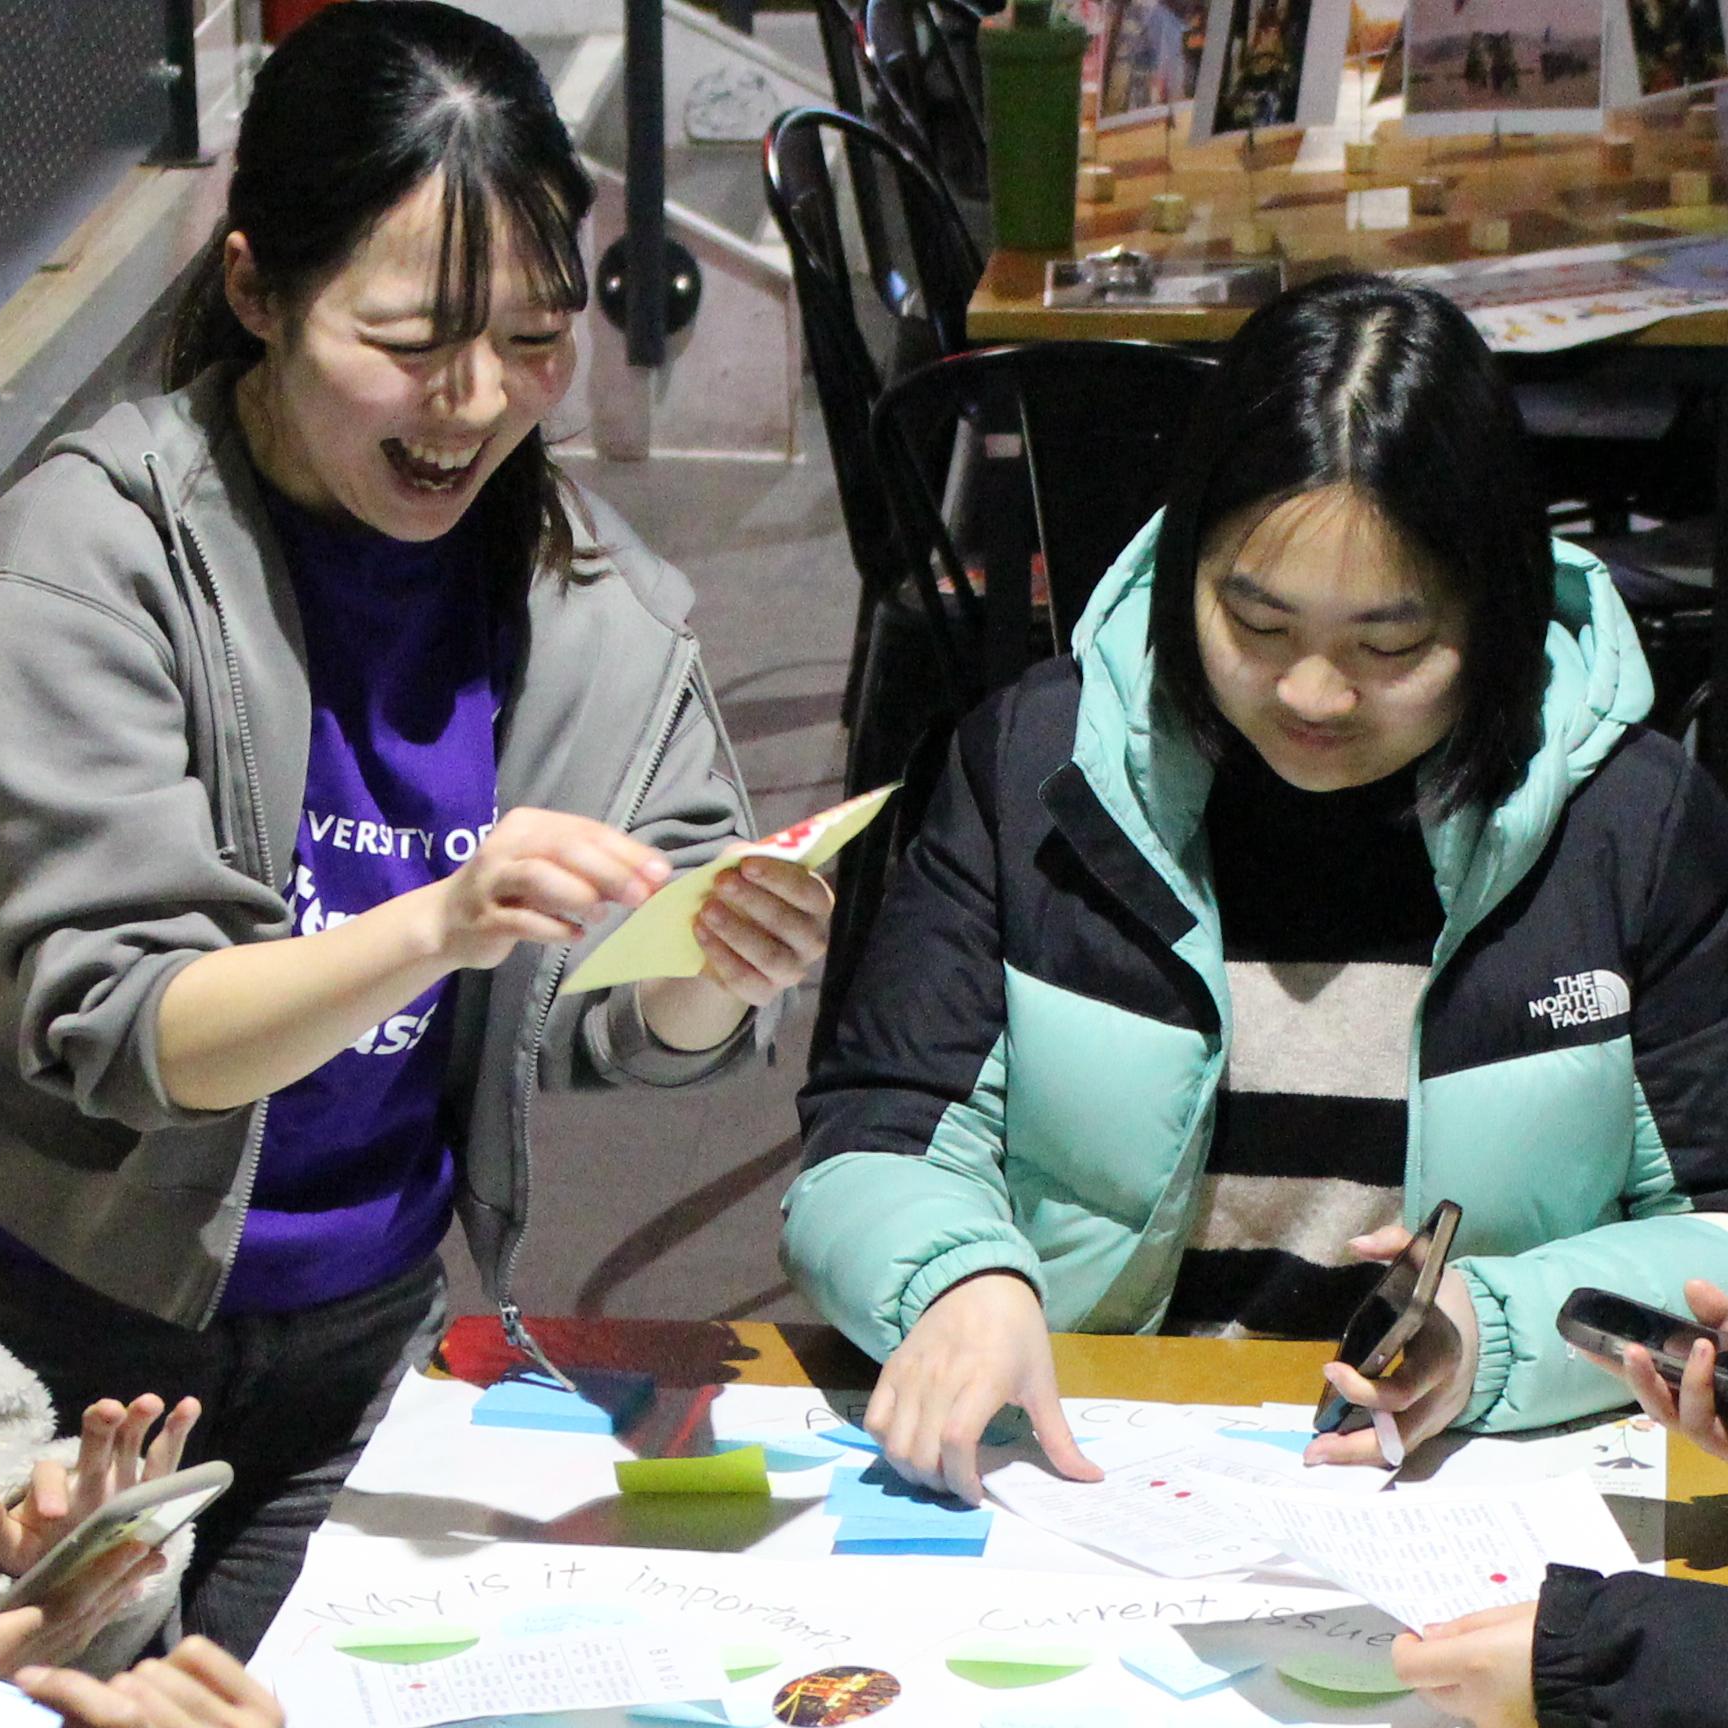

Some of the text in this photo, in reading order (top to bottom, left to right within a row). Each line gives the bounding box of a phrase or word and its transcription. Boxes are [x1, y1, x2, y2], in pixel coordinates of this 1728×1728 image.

[306, 809, 435, 861] VERSITY
[1553, 970, 1594, 994] THE
[1527, 988, 1597, 1018] NORTH
[1550, 1007, 1603, 1030] FACE
[304, 1586, 445, 1630] Why
[467, 1570, 510, 1596] is
[544, 1560, 588, 1591] it
[624, 1564, 855, 1651] important?
[977, 1593, 1219, 1634] Current
